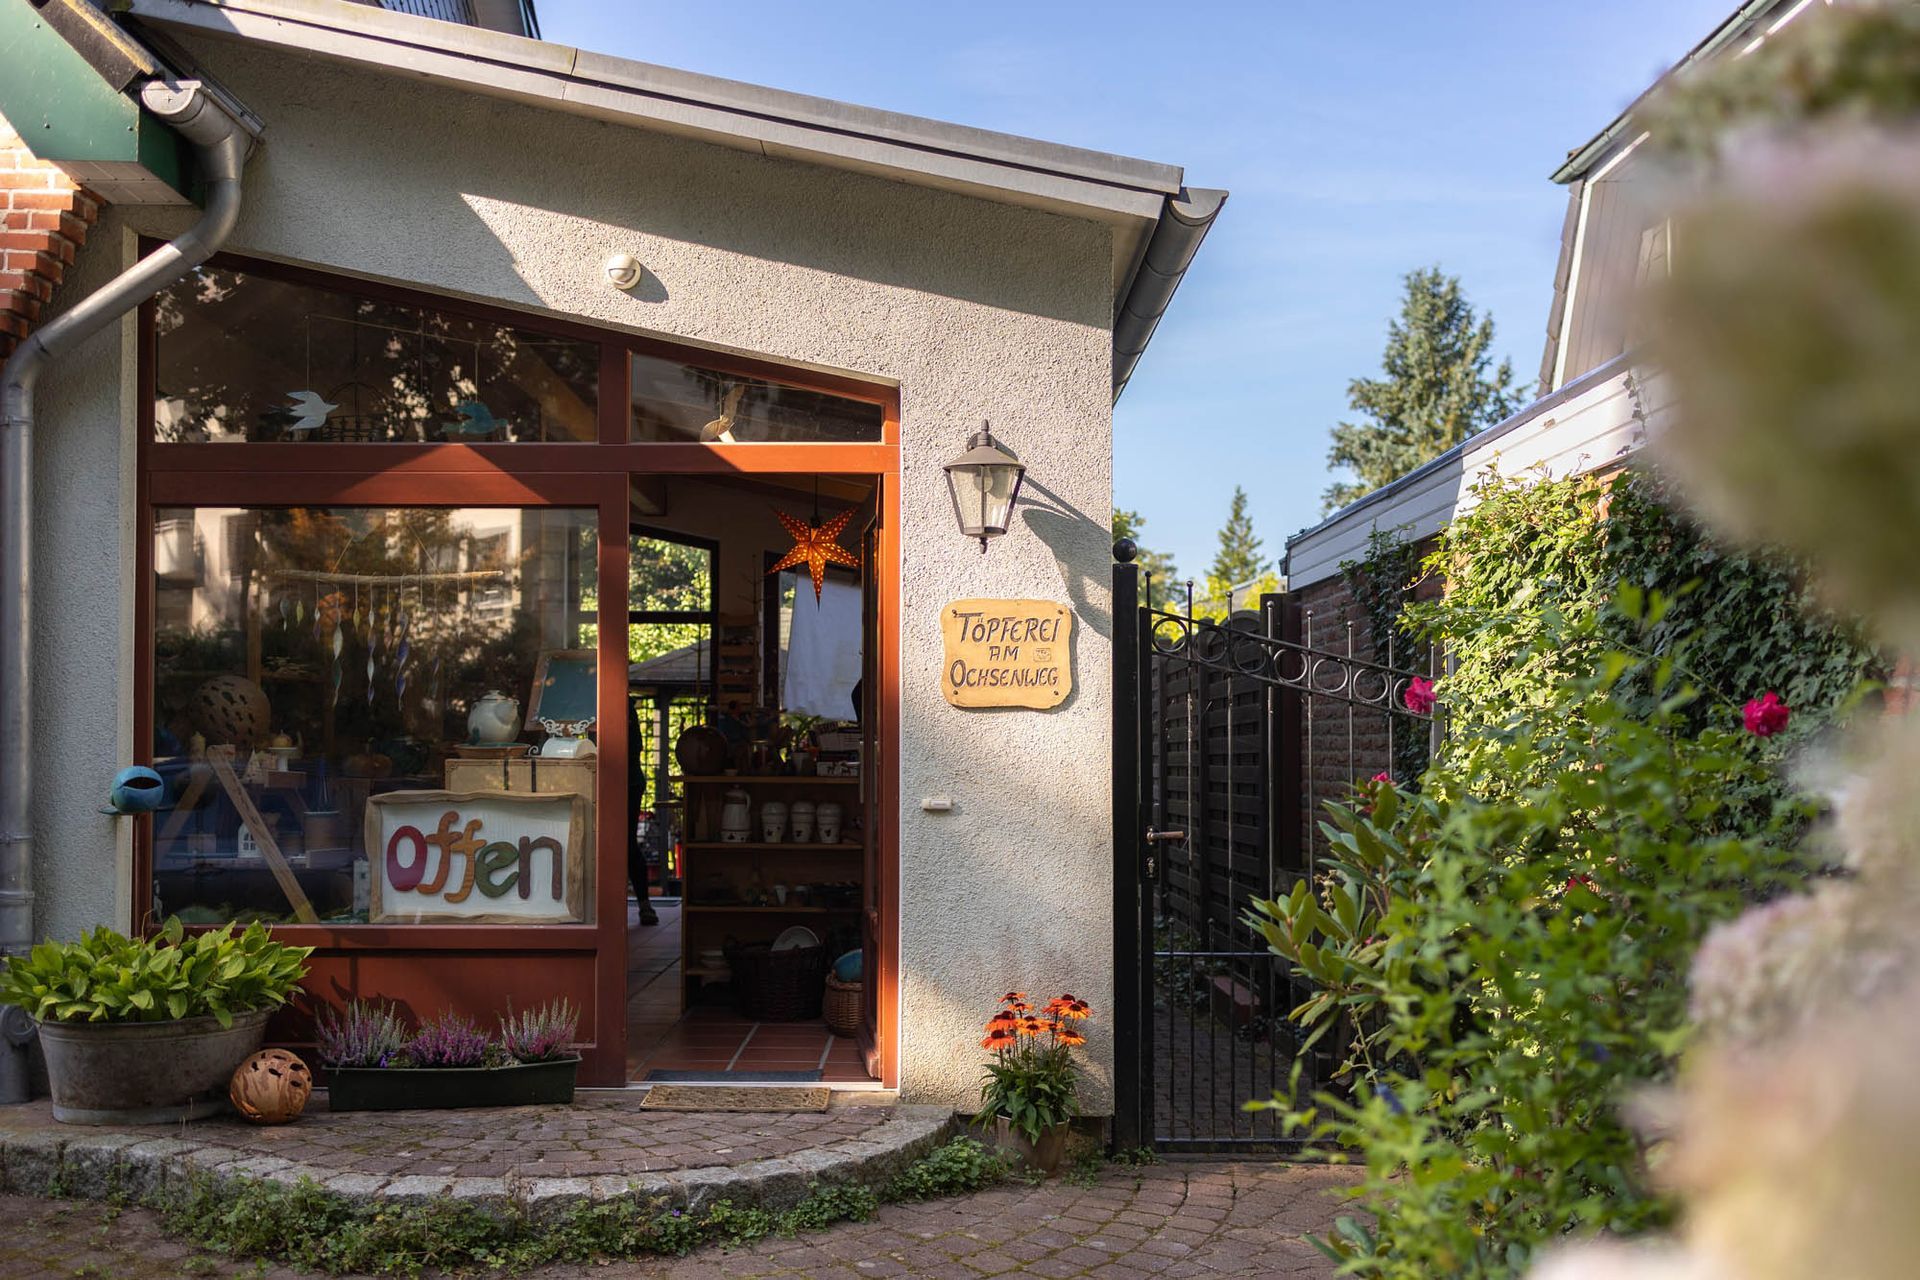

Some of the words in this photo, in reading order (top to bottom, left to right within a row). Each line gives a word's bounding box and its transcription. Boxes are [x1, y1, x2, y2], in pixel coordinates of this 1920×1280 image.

[955, 612, 1060, 642] TÖPFEREI
[989, 645, 1019, 661] AM
[950, 659, 1058, 687] OCHSENWEG
